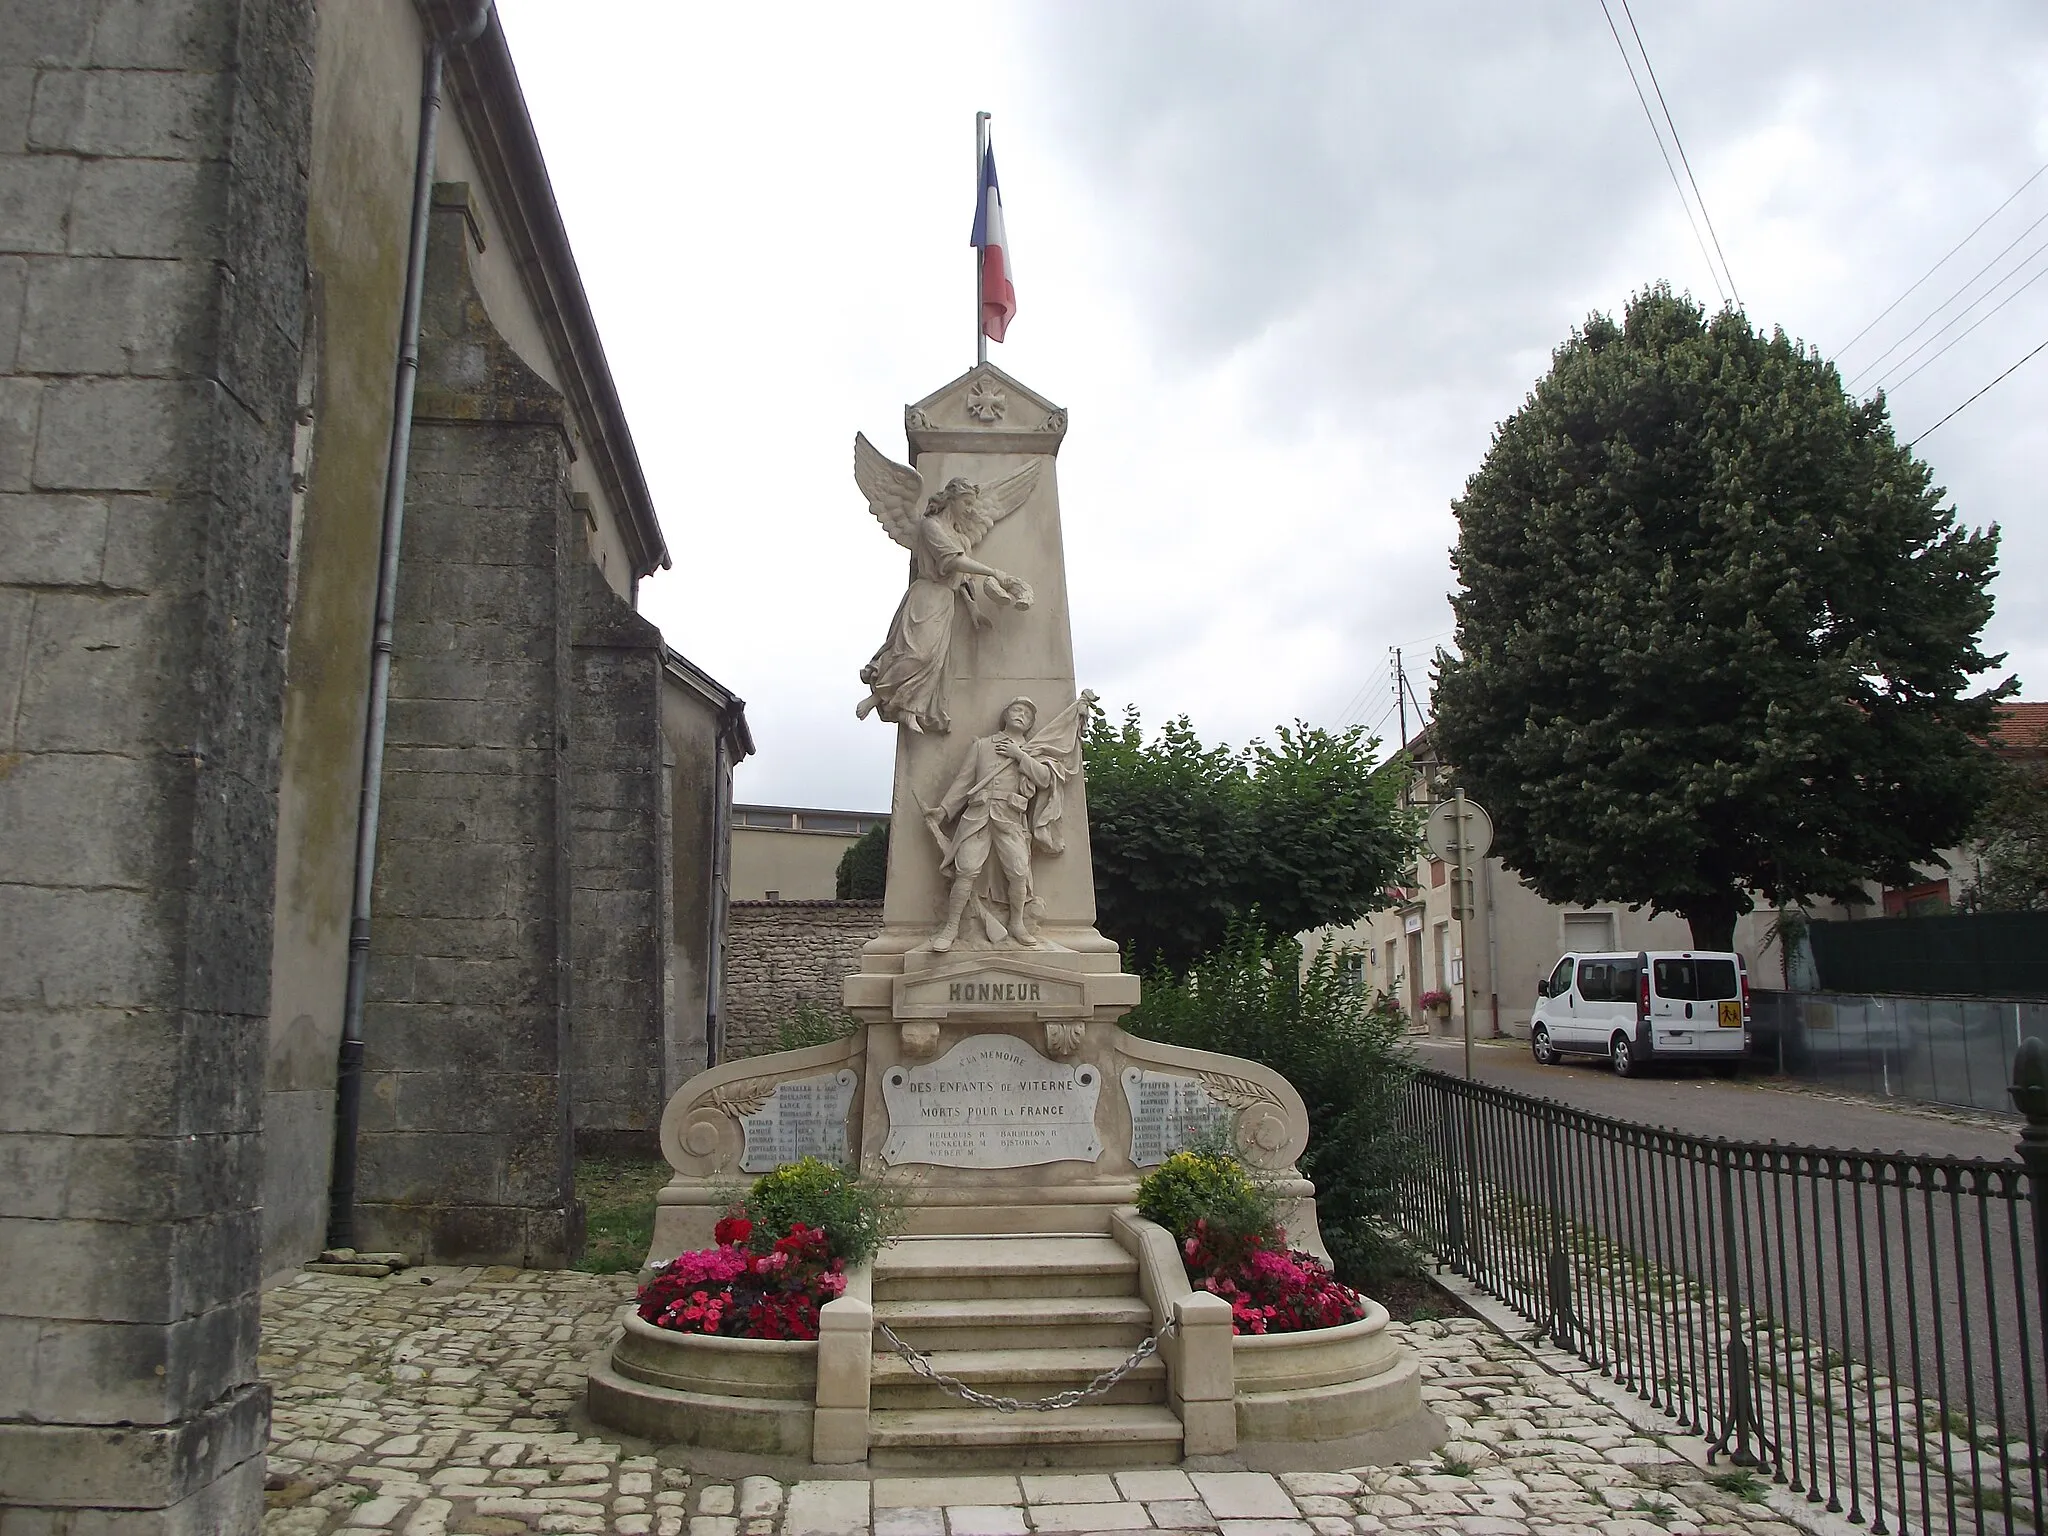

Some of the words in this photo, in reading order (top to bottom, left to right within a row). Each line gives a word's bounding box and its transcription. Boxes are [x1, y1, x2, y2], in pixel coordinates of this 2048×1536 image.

[949, 983, 1041, 1001] HONNEUR
[910, 1082, 932, 1093] DES
[940, 1082, 994, 1092] ENFANTS
[1001, 1083, 1012, 1092] DE
[1020, 1081, 1073, 1091] VITERNE
[921, 1107, 960, 1117] MORTS
[968, 1107, 998, 1116] POUR
[1020, 1106, 1064, 1115] FRANCE
